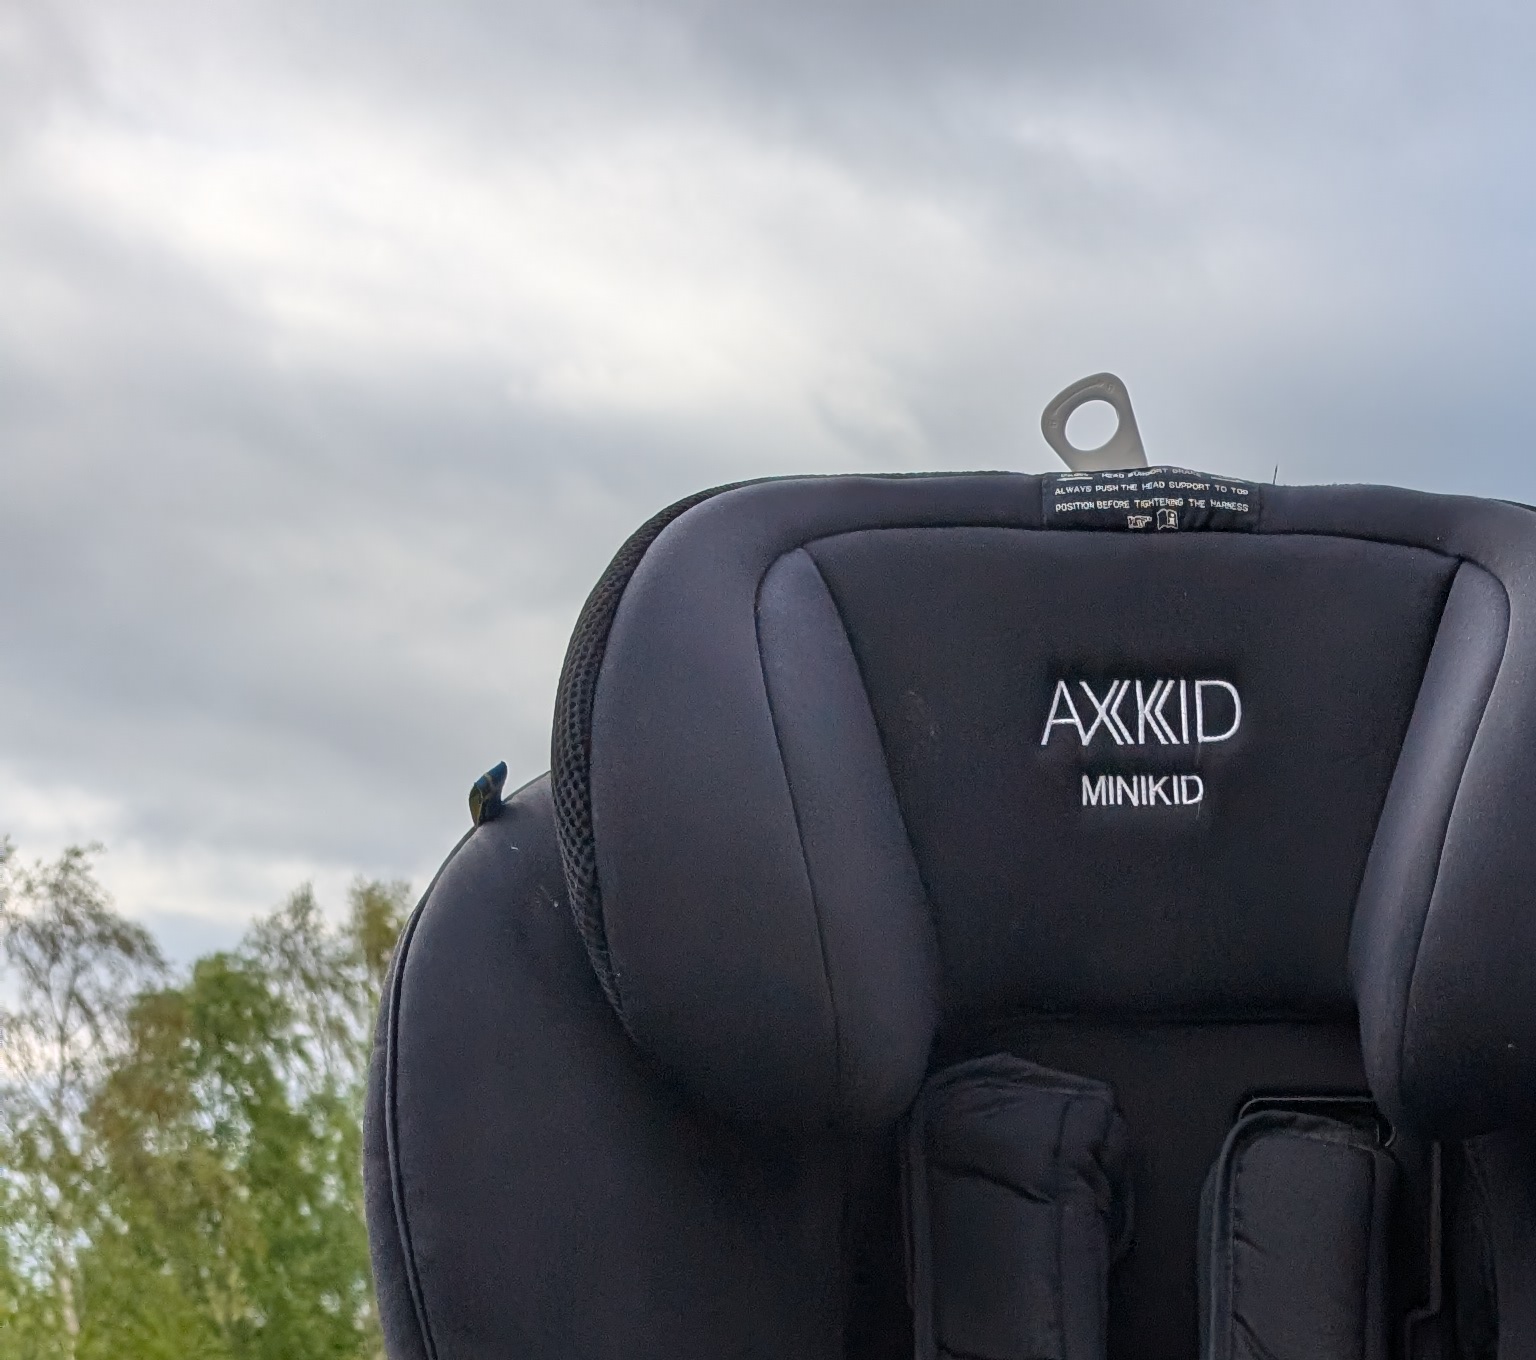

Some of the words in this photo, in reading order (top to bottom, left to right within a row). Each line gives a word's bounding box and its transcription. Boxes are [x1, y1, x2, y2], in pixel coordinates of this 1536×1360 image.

[1055, 485, 1093, 496] ALWAYS
[1095, 484, 1119, 493] PUSH
[1121, 483, 1138, 491] THE
[1142, 481, 1165, 491] HEAD
[1168, 481, 1211, 491] SUPPORT
[1214, 484, 1228, 493] TO
[1231, 486, 1249, 496] TOP
[1055, 501, 1095, 513] POSITION
[1096, 499, 1130, 510] BEFORE
[1134, 497, 1184, 508] TIGHTENING
[1188, 498, 1206, 509] THE
[1210, 499, 1249, 512] HARNESS
[1081, 774, 1204, 807] MINIKID
